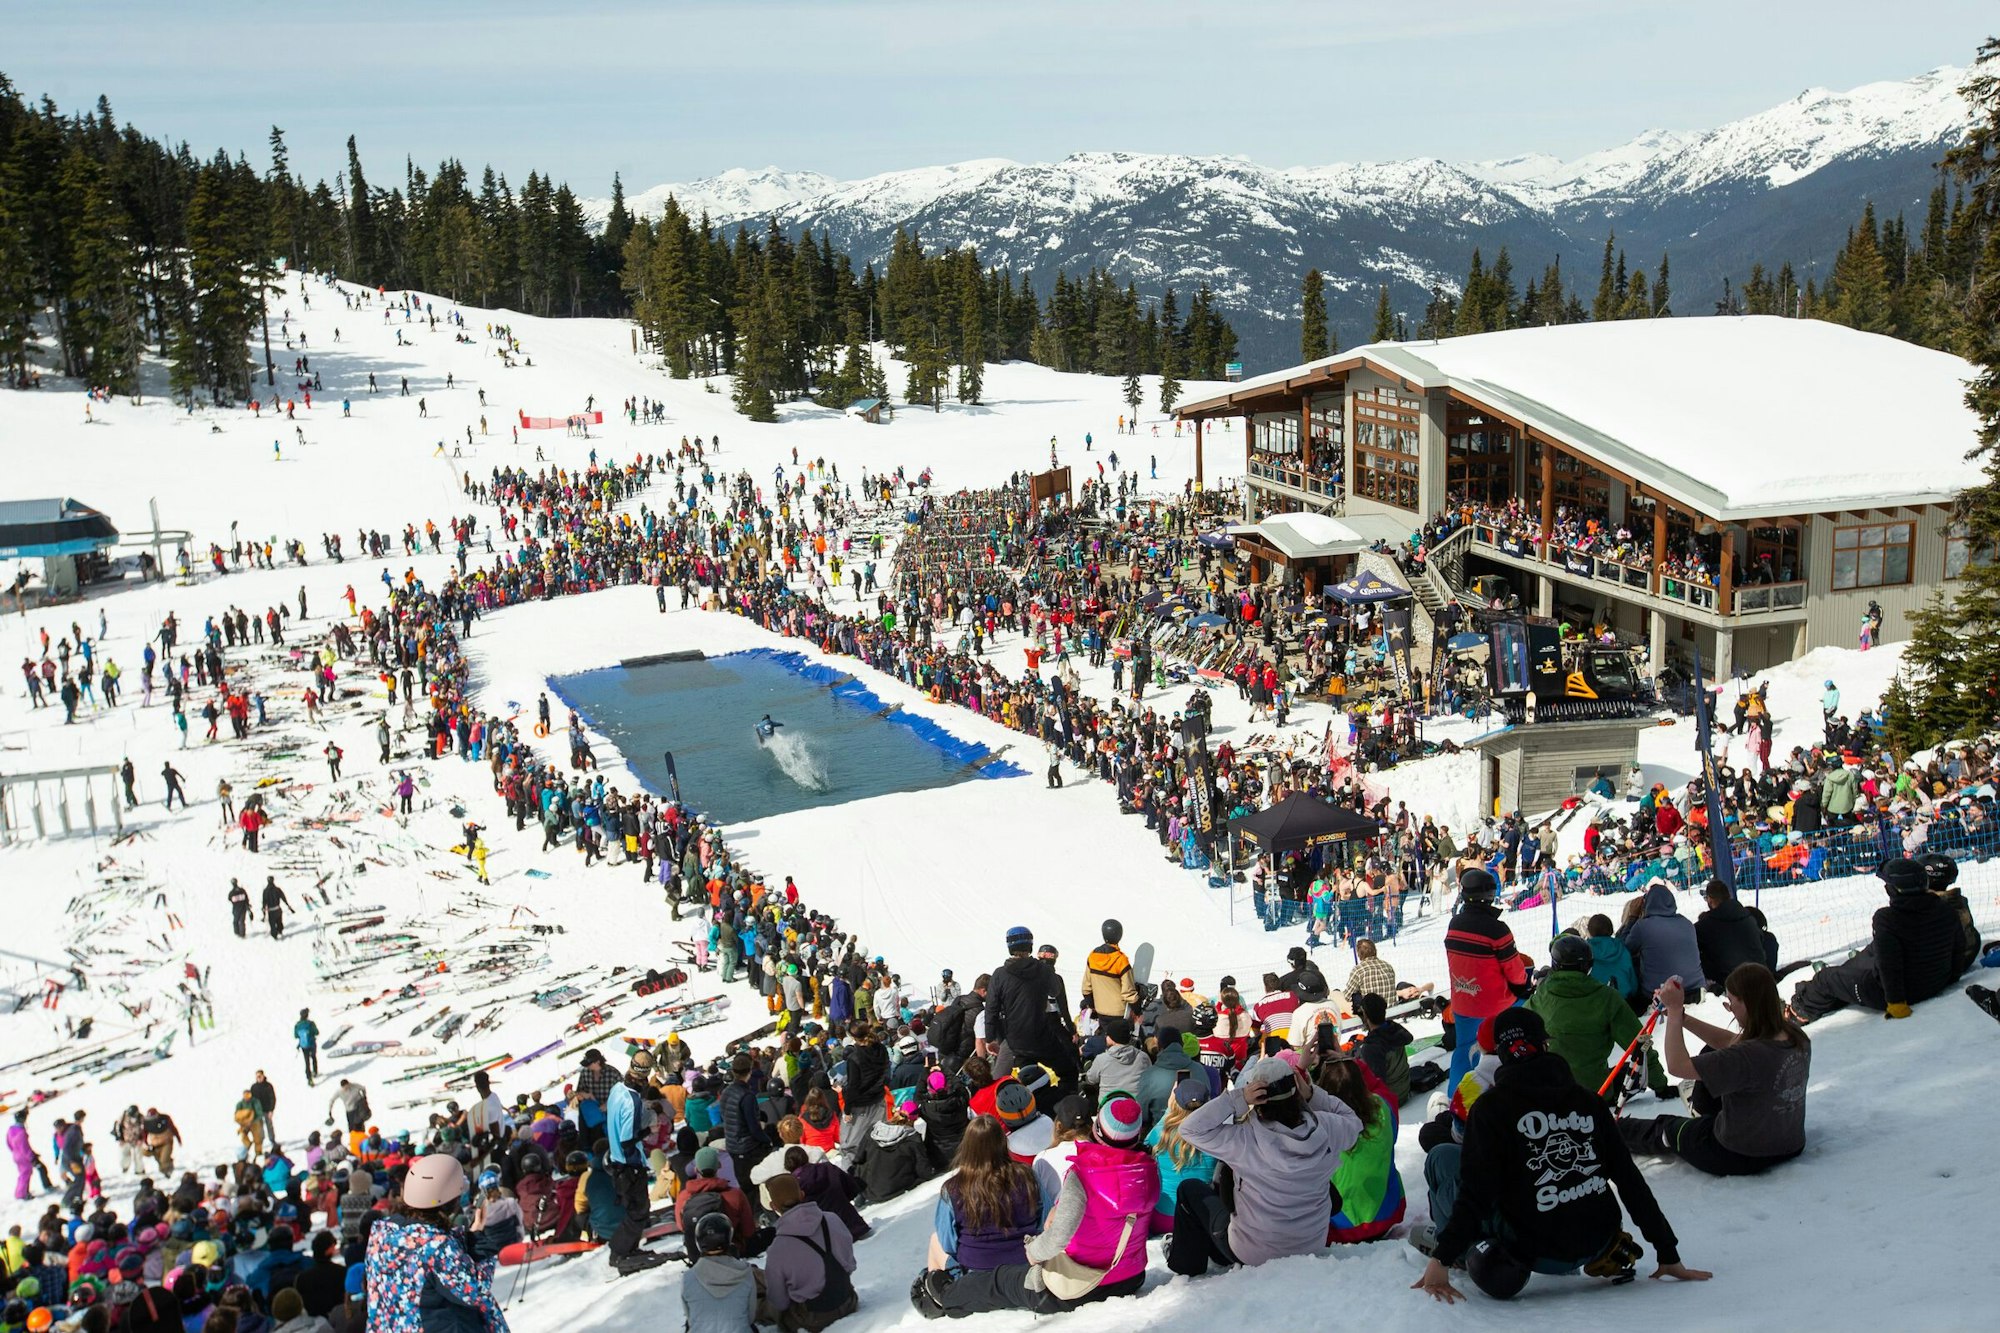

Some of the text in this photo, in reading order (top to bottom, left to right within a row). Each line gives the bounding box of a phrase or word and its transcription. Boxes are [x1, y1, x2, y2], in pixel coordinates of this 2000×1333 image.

[1360, 586, 1394, 596] Corona
[1316, 832, 1347, 842] ROCKSTAR
[1517, 1111, 1595, 1140] Dirty
[1536, 1175, 1607, 1212] South
